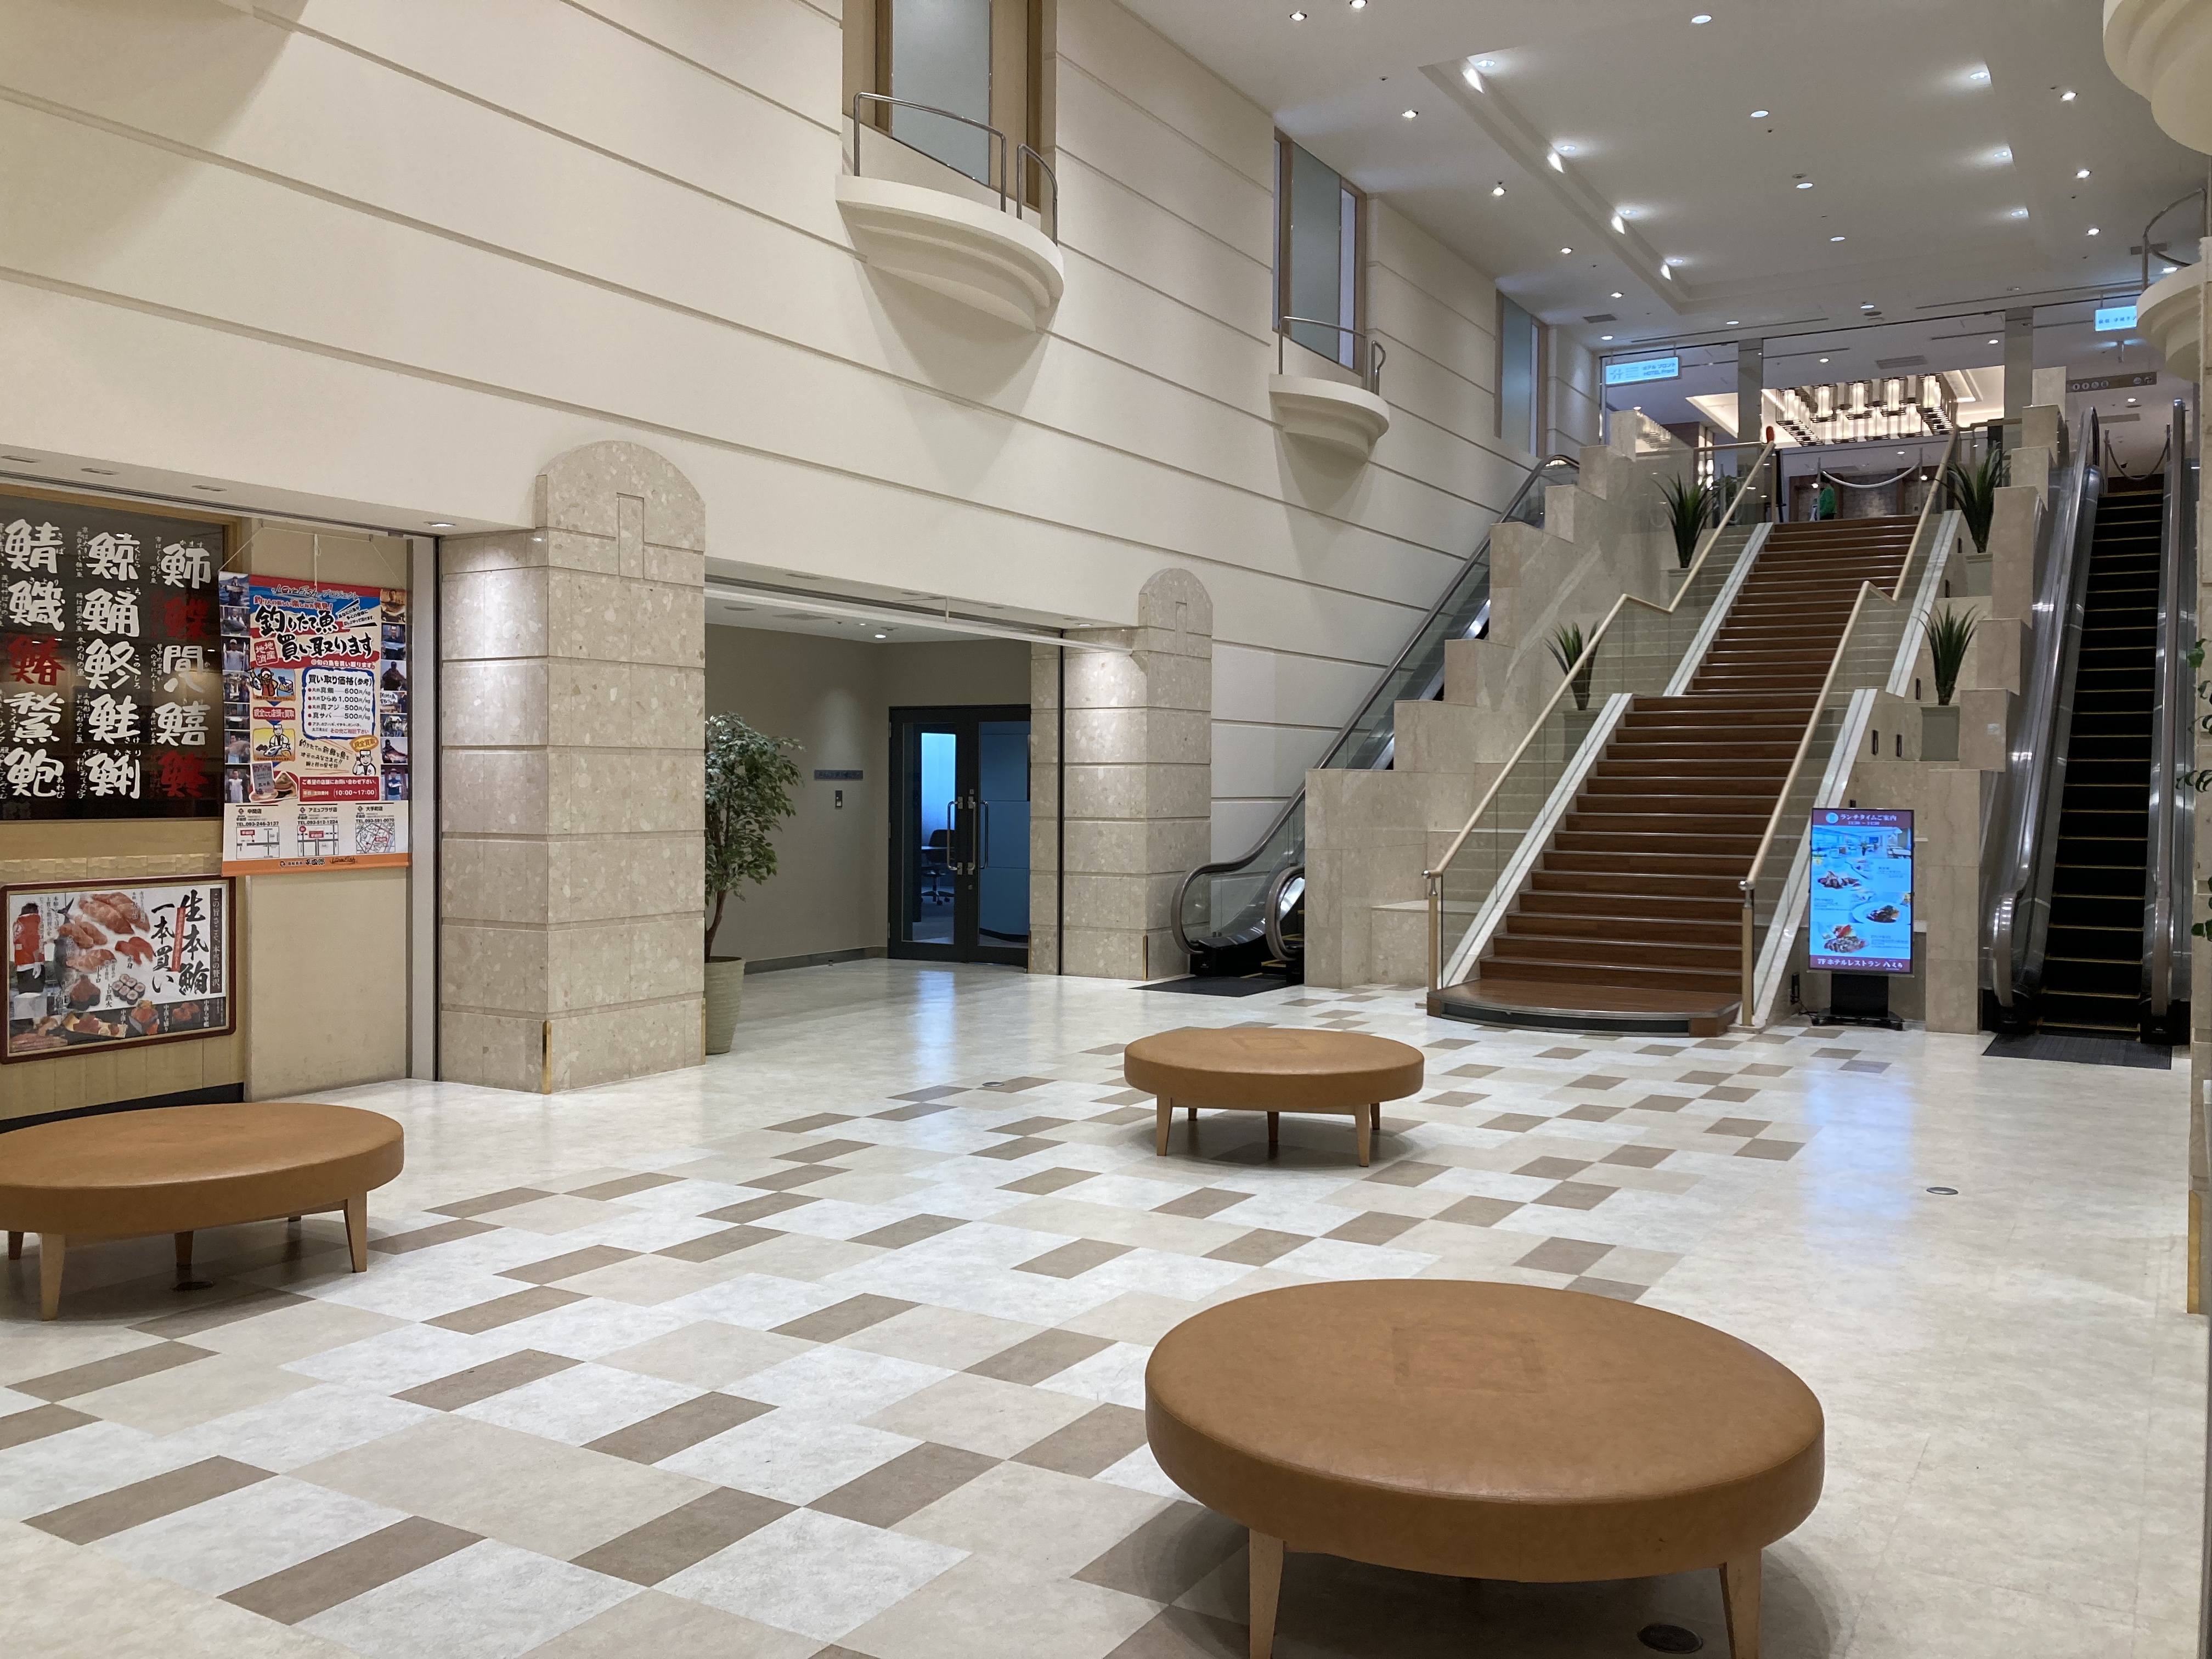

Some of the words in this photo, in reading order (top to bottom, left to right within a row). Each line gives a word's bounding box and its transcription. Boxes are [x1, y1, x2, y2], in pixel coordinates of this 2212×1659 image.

[5, 518, 63, 573] 鯖
[87, 532, 140, 581] 鯨
[323, 589, 359, 600] プロジェクト
[255, 606, 337, 636] 釣りたて魚
[277, 633, 373, 661] 買い取ります
[89, 694, 141, 744] 鮭
[4, 747, 64, 797] 鮑
[151, 903, 175, 994] 一本買い
[179, 889, 210, 996] 生本鮪
[1827, 959, 1881, 967] ホテルレストラン
